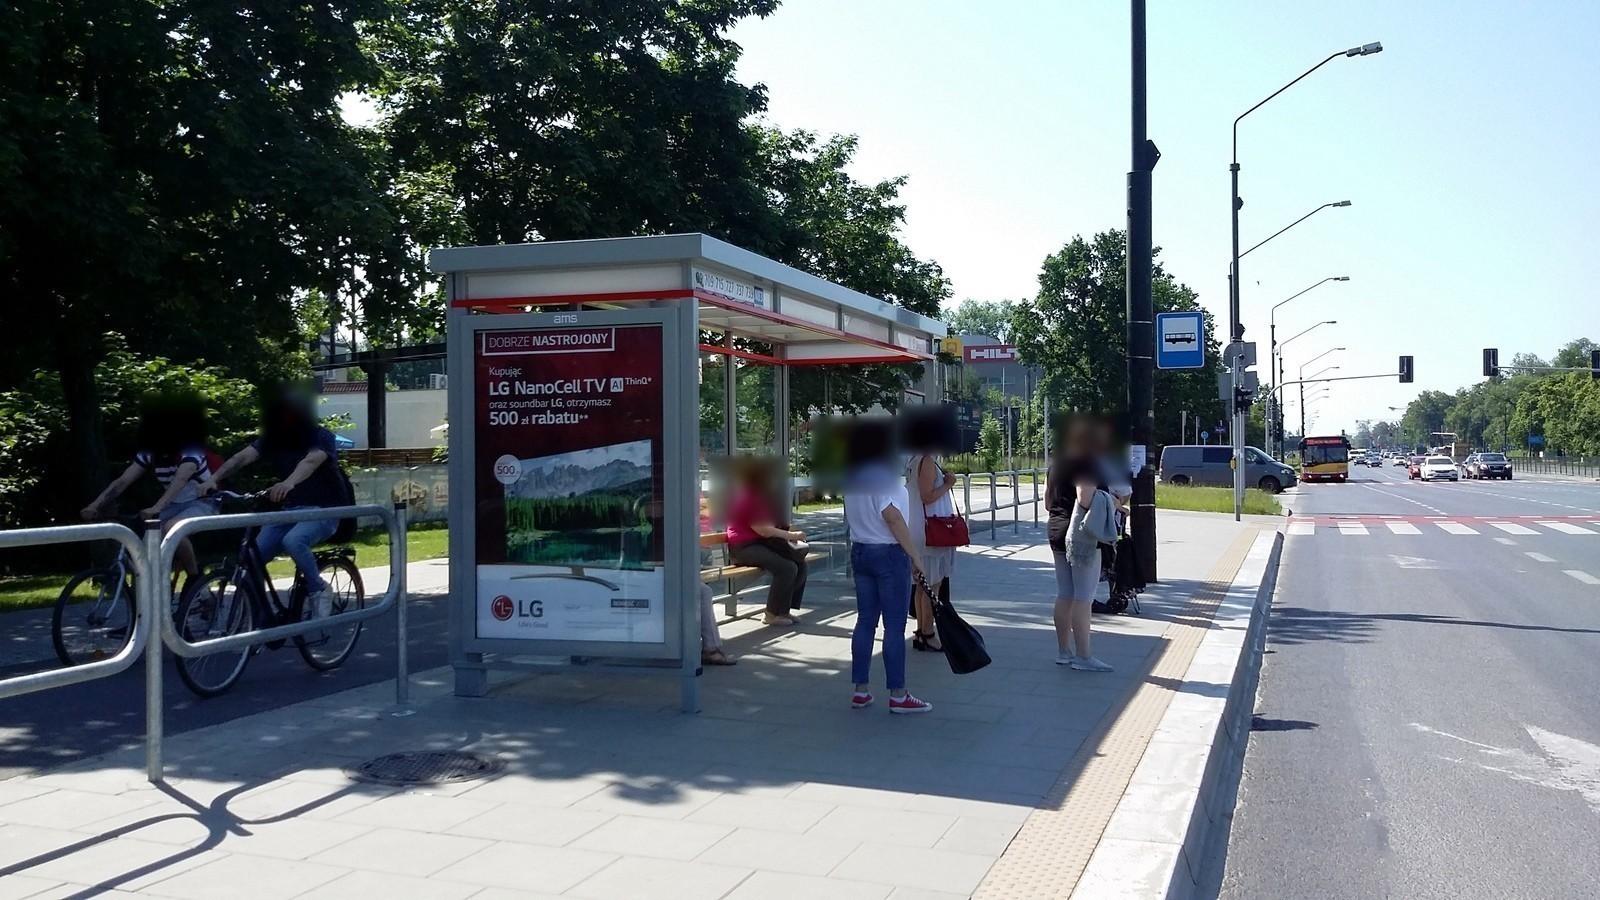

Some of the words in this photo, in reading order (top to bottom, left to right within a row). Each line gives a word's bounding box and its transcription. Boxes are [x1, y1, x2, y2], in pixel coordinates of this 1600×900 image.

[715, 277, 724, 290] 715
[553, 314, 578, 324] ams
[489, 335, 530, 348] DOBRZE
[532, 333, 609, 346] NASTROJONY
[970, 348, 1017, 360] HILT
[489, 367, 522, 377] Kupując
[489, 381, 510, 396] LG
[515, 379, 582, 395] NanoCell
[584, 378, 607, 393] TV
[611, 378, 623, 392] AI
[489, 401, 508, 409] oraz
[509, 398, 549, 409] soundbar
[551, 398, 565, 409] LG,
[566, 398, 612, 410] otrzymasz
[489, 411, 518, 426] 500
[521, 416, 530, 425] zł
[497, 465, 515, 475] 500
[518, 599, 544, 618] LG
